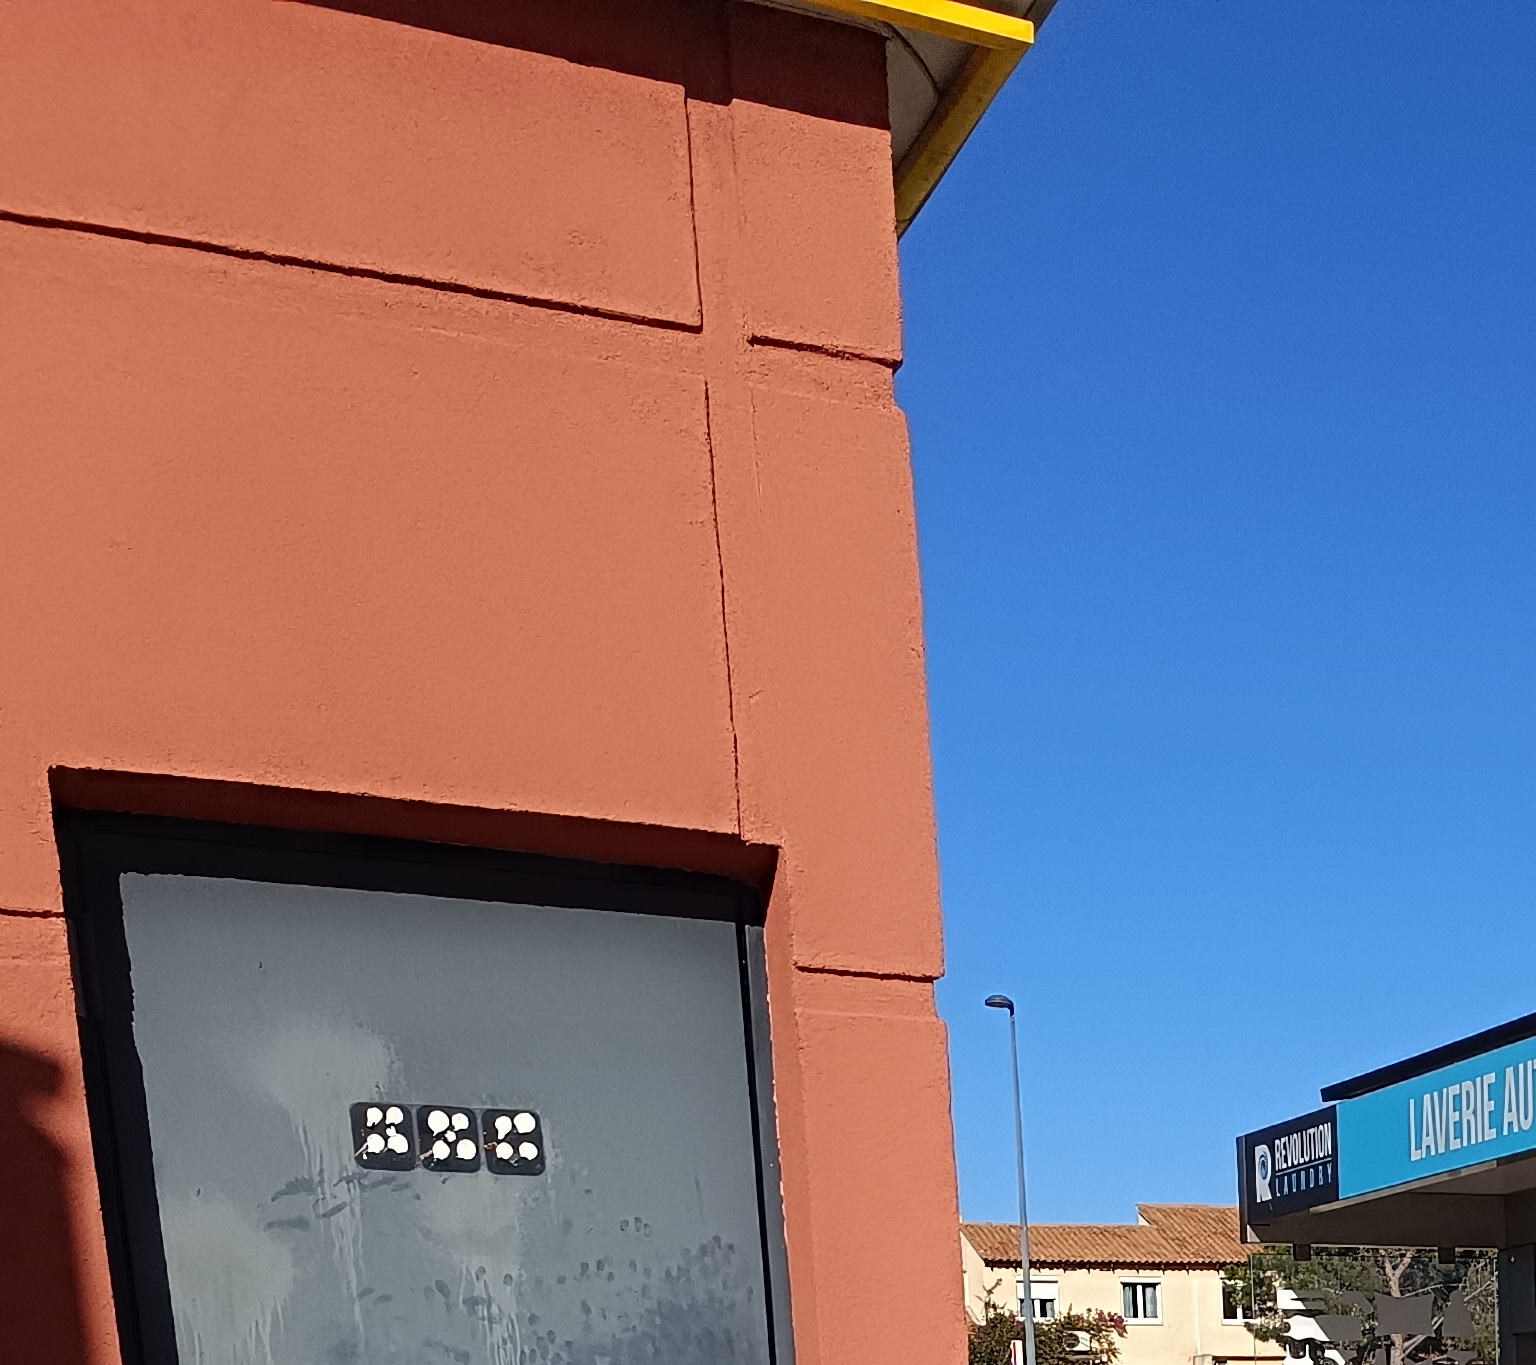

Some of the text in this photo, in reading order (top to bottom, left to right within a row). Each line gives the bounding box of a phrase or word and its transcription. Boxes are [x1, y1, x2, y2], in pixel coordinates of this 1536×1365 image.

[1408, 1072, 1497, 1162] LAVERIE
[1274, 1121, 1333, 1171] REVOLUTION
[1275, 1162, 1333, 1198] LAUNDRY
